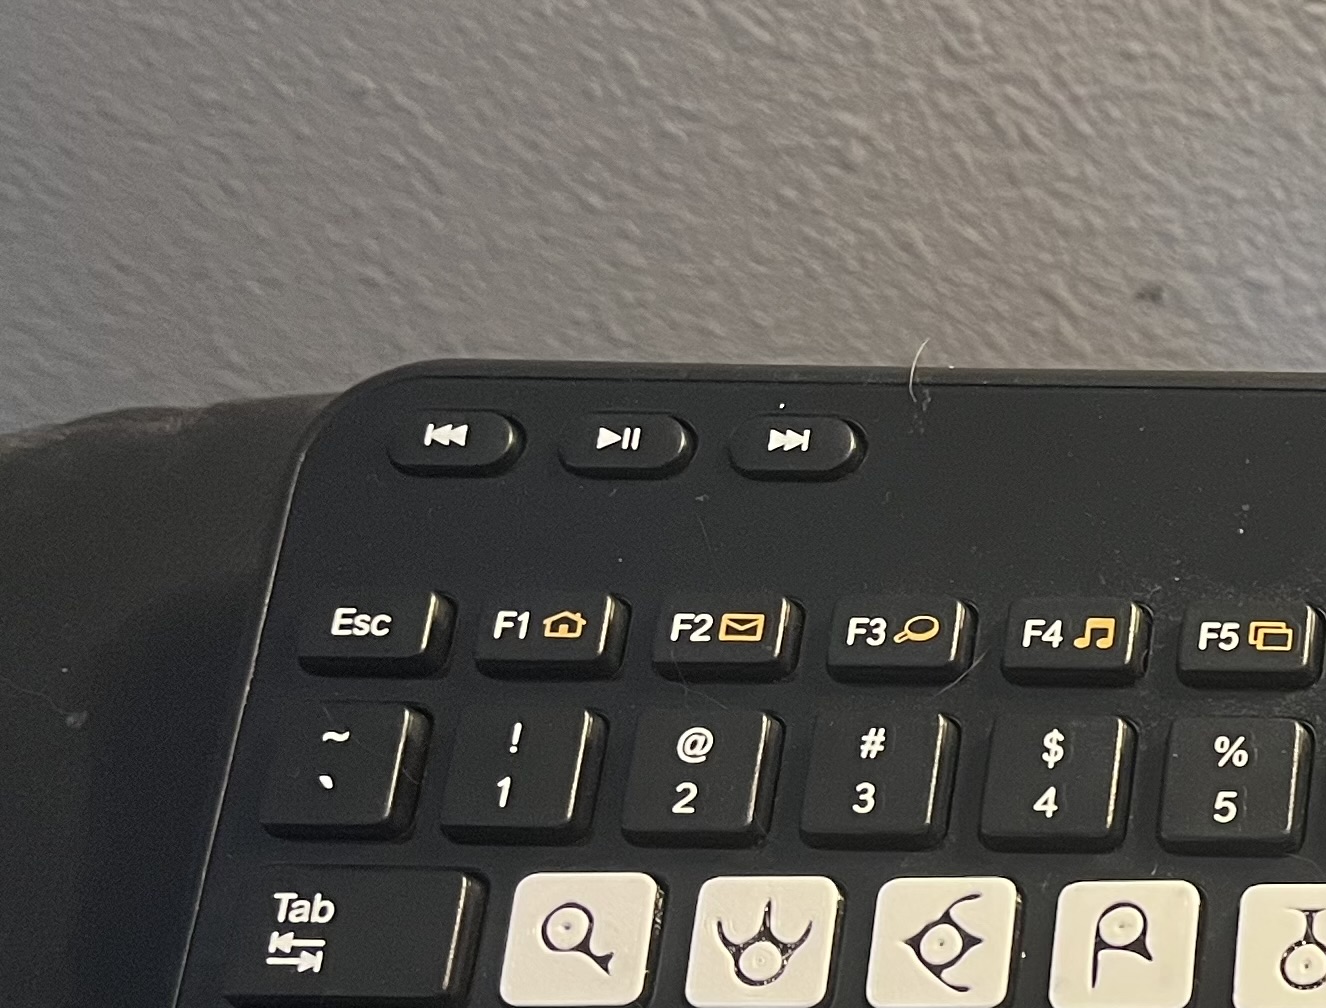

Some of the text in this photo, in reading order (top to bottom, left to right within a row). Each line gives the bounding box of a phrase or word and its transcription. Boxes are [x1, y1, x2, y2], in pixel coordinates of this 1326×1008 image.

[330, 607, 392, 638] Esc
[493, 611, 530, 639] F1
[670, 612, 714, 642] F2
[846, 616, 886, 647] F3
[1021, 619, 1064, 649] F4
[1198, 621, 1240, 652] F5
[496, 777, 512, 807] 1
[672, 783, 698, 814] 2
[852, 783, 876, 814] 3
[1033, 788, 1059, 817] 4
[1213, 792, 1238, 823] 5
[272, 893, 335, 925] Tab
